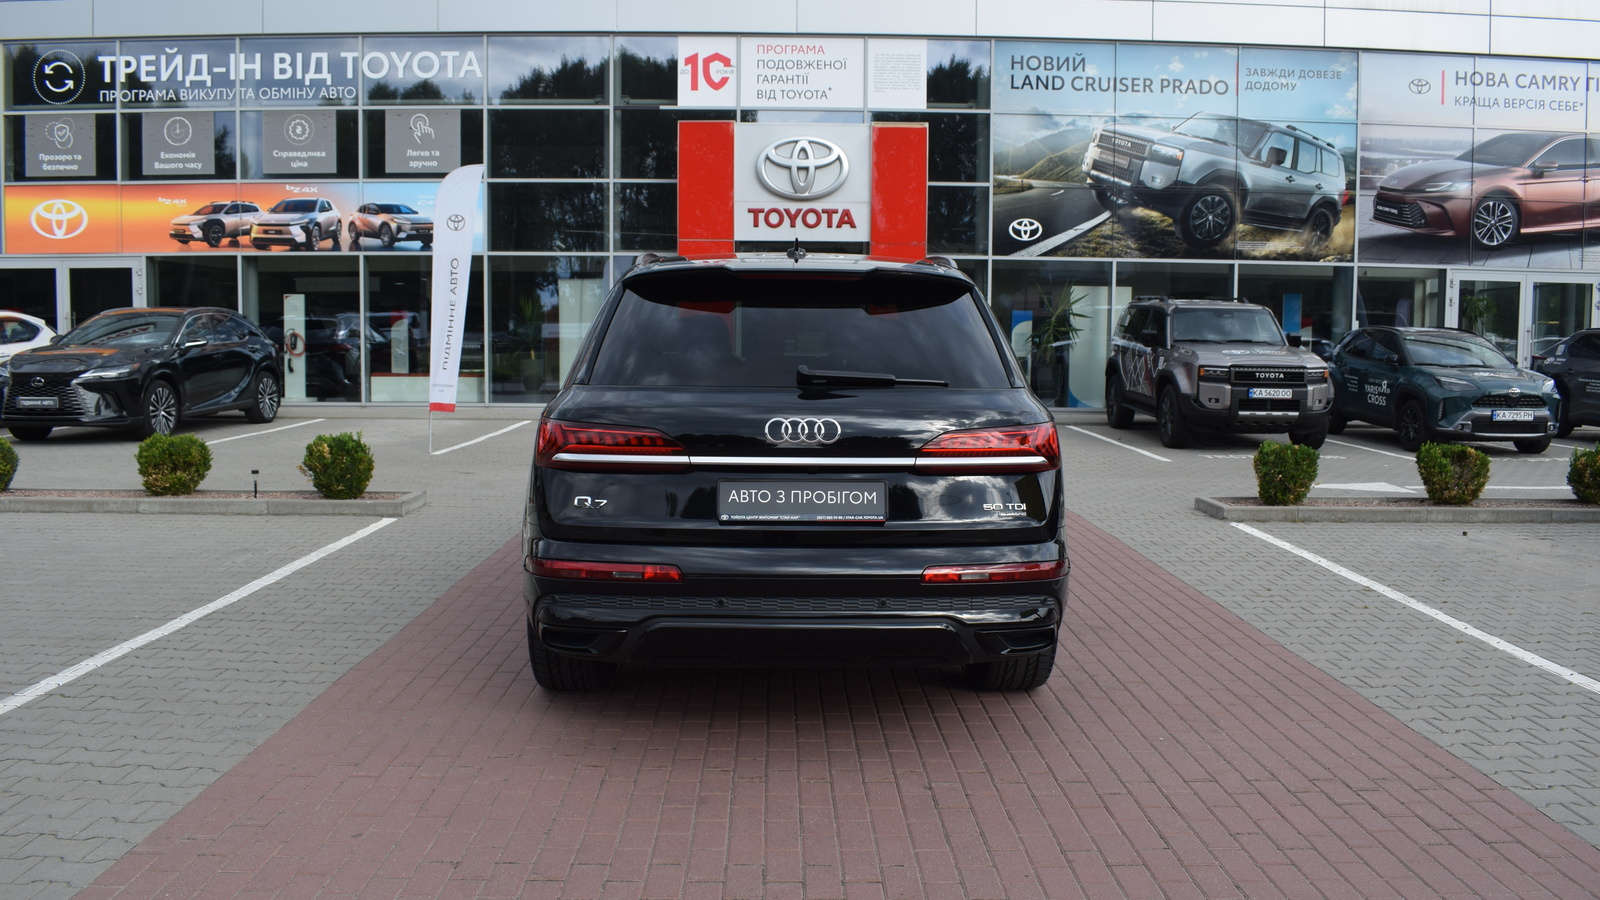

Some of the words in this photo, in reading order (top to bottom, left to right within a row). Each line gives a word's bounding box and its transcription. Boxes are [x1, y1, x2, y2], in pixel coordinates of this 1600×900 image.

[756, 44, 825, 55] ПРОГРАМА
[98, 47, 261, 87] ТРЕЙД-ІН
[273, 52, 332, 86] ВІД
[341, 51, 483, 80] TOYOTA
[756, 57, 848, 71] ПОДОВЖЕНОЇ
[1010, 53, 1086, 72] НОВИЙ
[756, 71, 810, 84] ГАРАНТІЇ
[1245, 67, 1296, 80] ЗАВЖДИ
[1298, 69, 1343, 81] ДОВЕЗЕ
[1010, 74, 1065, 92] LAND
[1070, 76, 1154, 94] CRUISER
[1160, 79, 1229, 95] PRADO
[1245, 80, 1298, 93] ДОДОМУ
[1455, 70, 1509, 88] НОВА
[1515, 73, 1581, 92] CAMRY
[100, 89, 176, 102] ПРОГРАМА
[180, 88, 236, 101] ВИКУПУ
[239, 88, 255, 99] ТА
[259, 86, 316, 100] ОБМІНУ
[319, 86, 357, 99] АВТО
[756, 89, 777, 101] ВІД
[1454, 95, 1500, 109] КРАЩА
[1504, 98, 1545, 110] ВЕРСІЯ
[39, 153, 72, 162] Прозоро
[160, 151, 196, 159] Економія
[273, 150, 326, 159] Справедлива
[406, 149, 429, 158] Легко
[42, 163, 78, 171] безпечно
[154, 161, 183, 170] Вашого
[184, 162, 203, 171] часу
[290, 160, 308, 169] ціна
[408, 160, 438, 169] зручно
[747, 207, 857, 229] TOYOTA
[442, 300, 457, 371] ПІДМІННЕ
[450, 258, 460, 295] АВТО
[1253, 389, 1264, 397] KA
[1264, 389, 1280, 397] 5620
[1367, 393, 1387, 406] CROSS
[1496, 411, 1507, 419] KA
[1508, 411, 1522, 419] 7295
[1523, 411, 1533, 419] PH
[574, 496, 607, 509] Q7
[728, 489, 772, 503] АВТО
[790, 490, 877, 505] ПРОБІГОМ
[983, 503, 1003, 511] 50
[1006, 502, 1027, 511] TDI
